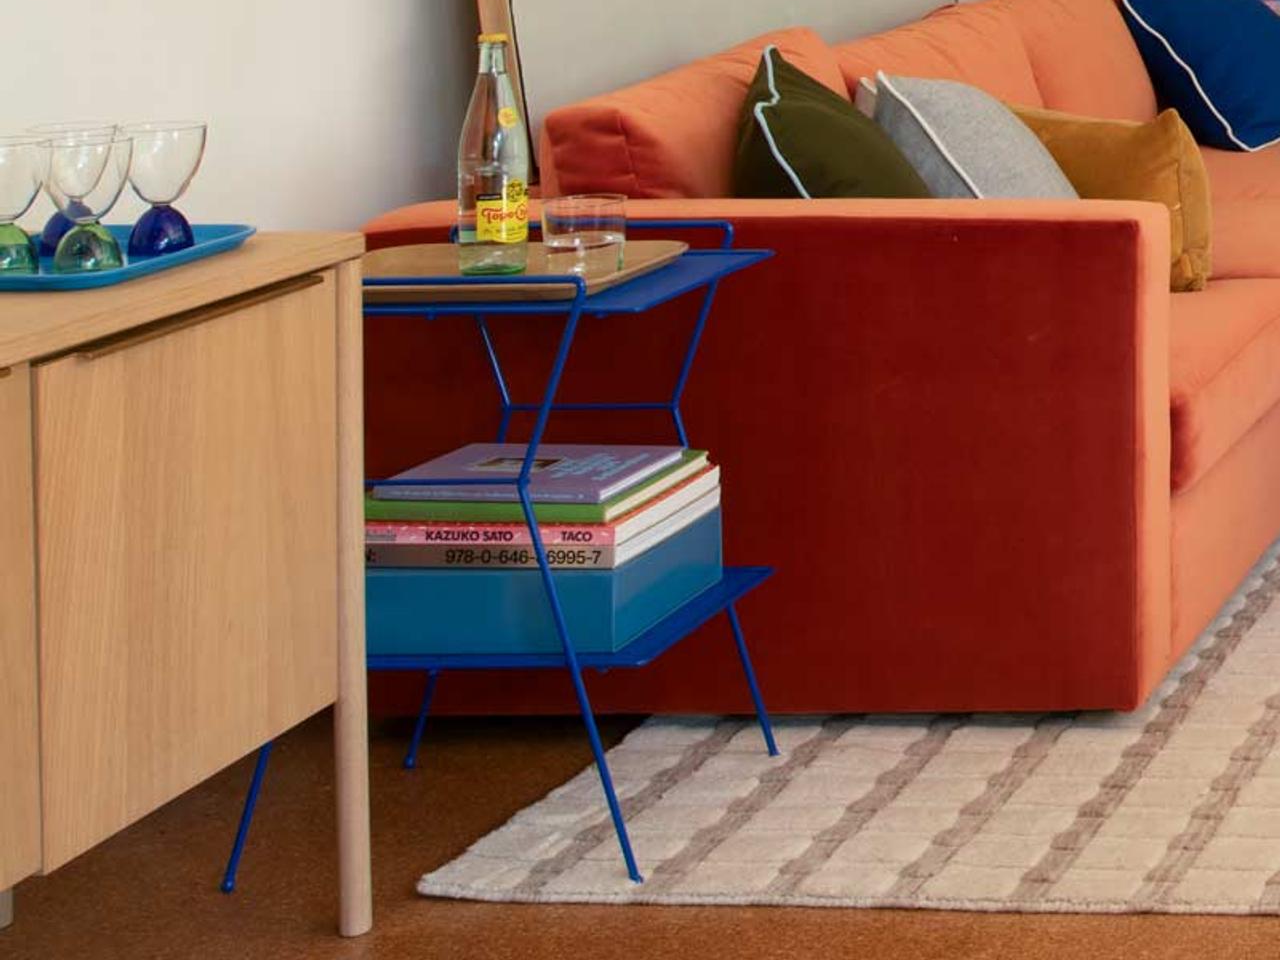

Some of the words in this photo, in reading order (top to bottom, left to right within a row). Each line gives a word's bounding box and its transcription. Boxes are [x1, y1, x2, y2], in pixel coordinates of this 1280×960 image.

[425, 530, 480, 541] KAZUKO
[483, 530, 514, 542] SATO
[561, 531, 593, 541] TACO
[445, 549, 602, 565] 978-0-646-6995-7
